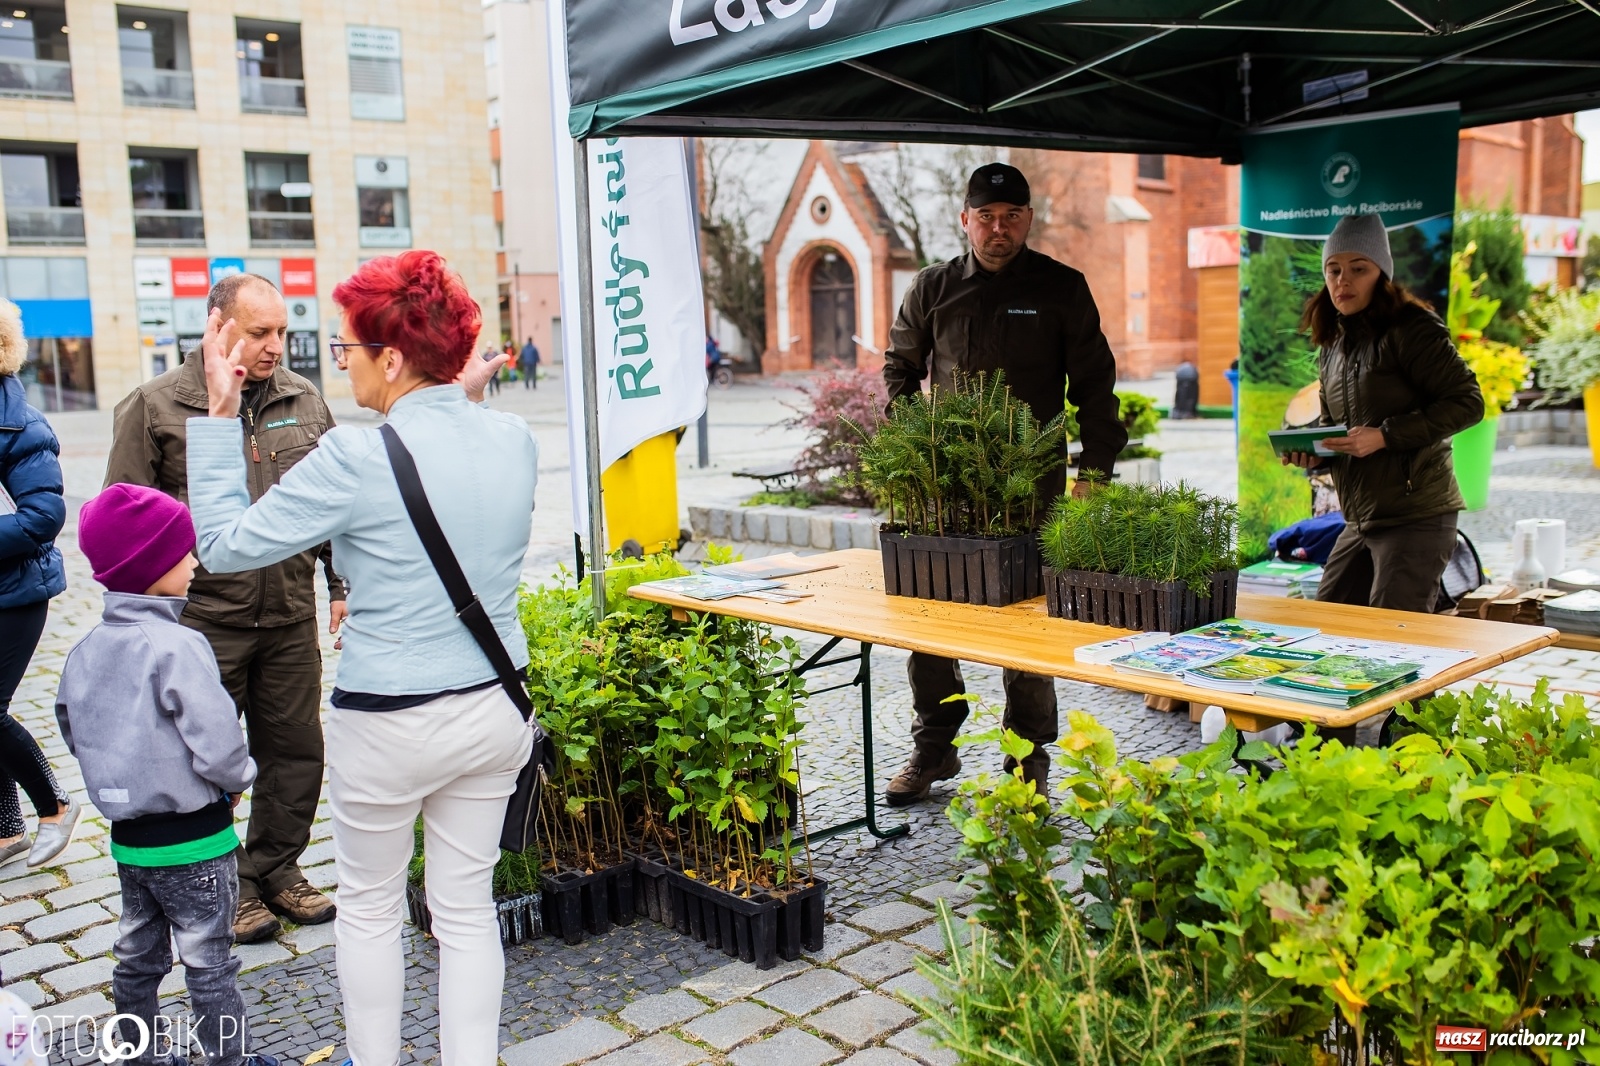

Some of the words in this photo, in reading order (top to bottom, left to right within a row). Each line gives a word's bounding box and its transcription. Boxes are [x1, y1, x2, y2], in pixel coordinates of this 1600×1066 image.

[1260, 208, 1330, 222] Nadleśnictwo
[1331, 204, 1358, 217] Rudy
[1360, 199, 1424, 215] Raciborskie
[616, 254, 662, 400] Rudy
